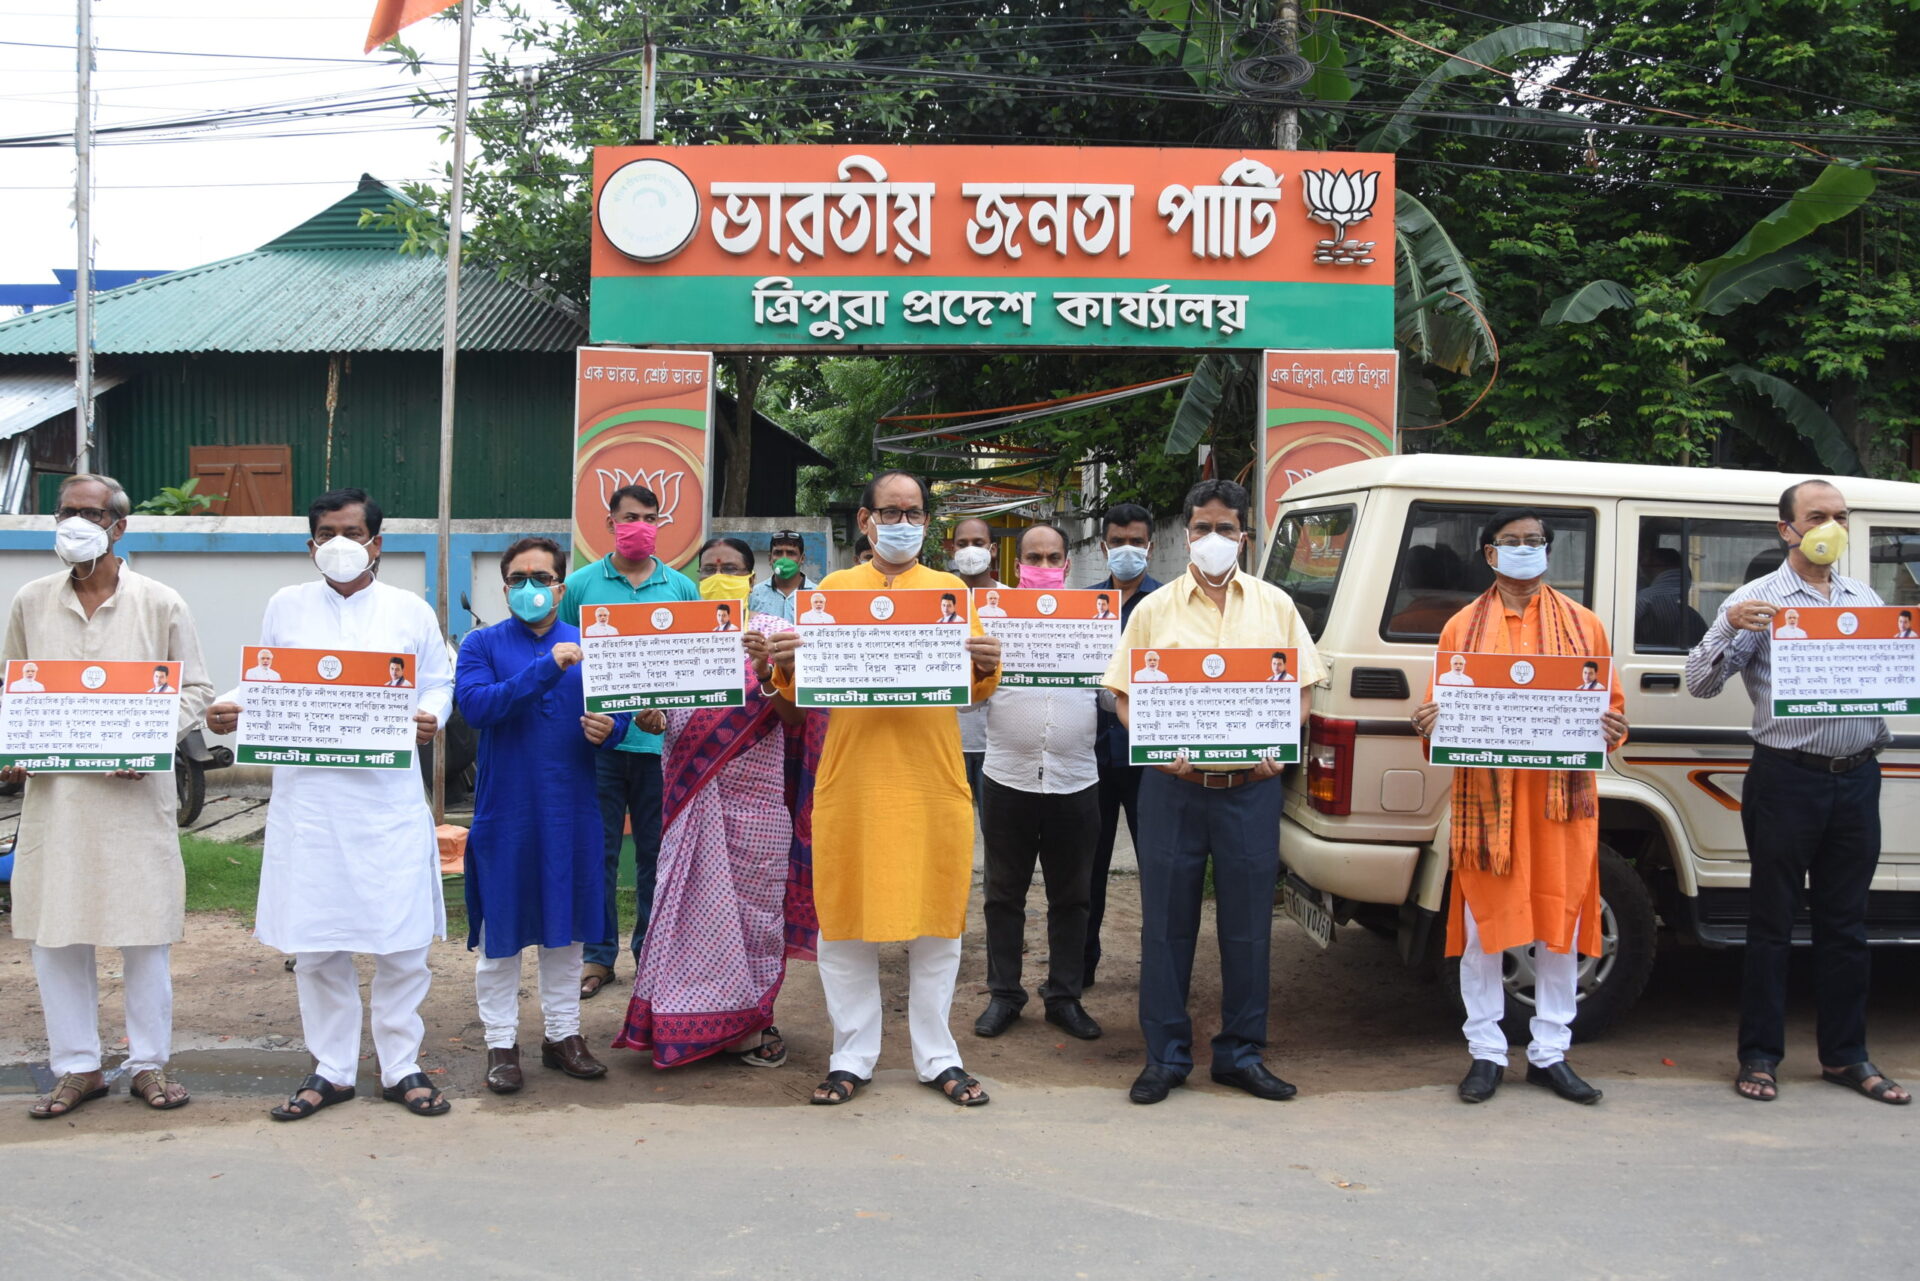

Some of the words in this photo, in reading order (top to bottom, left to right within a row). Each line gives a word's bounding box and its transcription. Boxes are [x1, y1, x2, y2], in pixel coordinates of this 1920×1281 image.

[711, 154, 935, 263] ভারতীয়
[962, 181, 1134, 259] জনতা
[1158, 158, 1283, 259] পার্টি
[752, 277, 889, 338] ত্রিপুরা
[903, 290, 1036, 325] প্রদেশ
[584, 367, 603, 380] এক
[607, 366, 640, 384] ভারত,
[644, 361, 668, 384] শ্রেষ্ঠ
[672, 369, 703, 384] ভারত
[1271, 368, 1289, 383] এক
[1291, 362, 1327, 389] ত্রিপুরা,
[1332, 363, 1355, 384] শ্রেষ্ঠ
[1358, 363, 1390, 389] ত্রিপুরা
[1038, 676, 1074, 684] জনতা
[601, 697, 651, 710] ভারতীয়
[656, 696, 696, 707] জনতা
[700, 692, 727, 705] পার্টি
[814, 690, 869, 703] ভারতীয়
[874, 692, 917, 702] জনতা
[922, 688, 952, 702] পার্টি
[1788, 702, 1837, 714] ভারতীয়
[1841, 704, 1879, 713] জনতা
[1882, 700, 1907, 713] পার্টি
[255, 748, 311, 763] ভারতীয়
[316, 753, 360, 764] জনতা
[365, 751, 395, 765] পার্টি
[1205, 750, 1247, 759] জনতা
[1252, 746, 1281, 759] পার্টি
[1449, 750, 1504, 764] ভারতীয়
[1508, 754, 1552, 765] জনতা
[1557, 752, 1587, 766] পার্টি
[75, 759, 121, 768] জনতা
[125, 756, 156, 768] পার্টি
